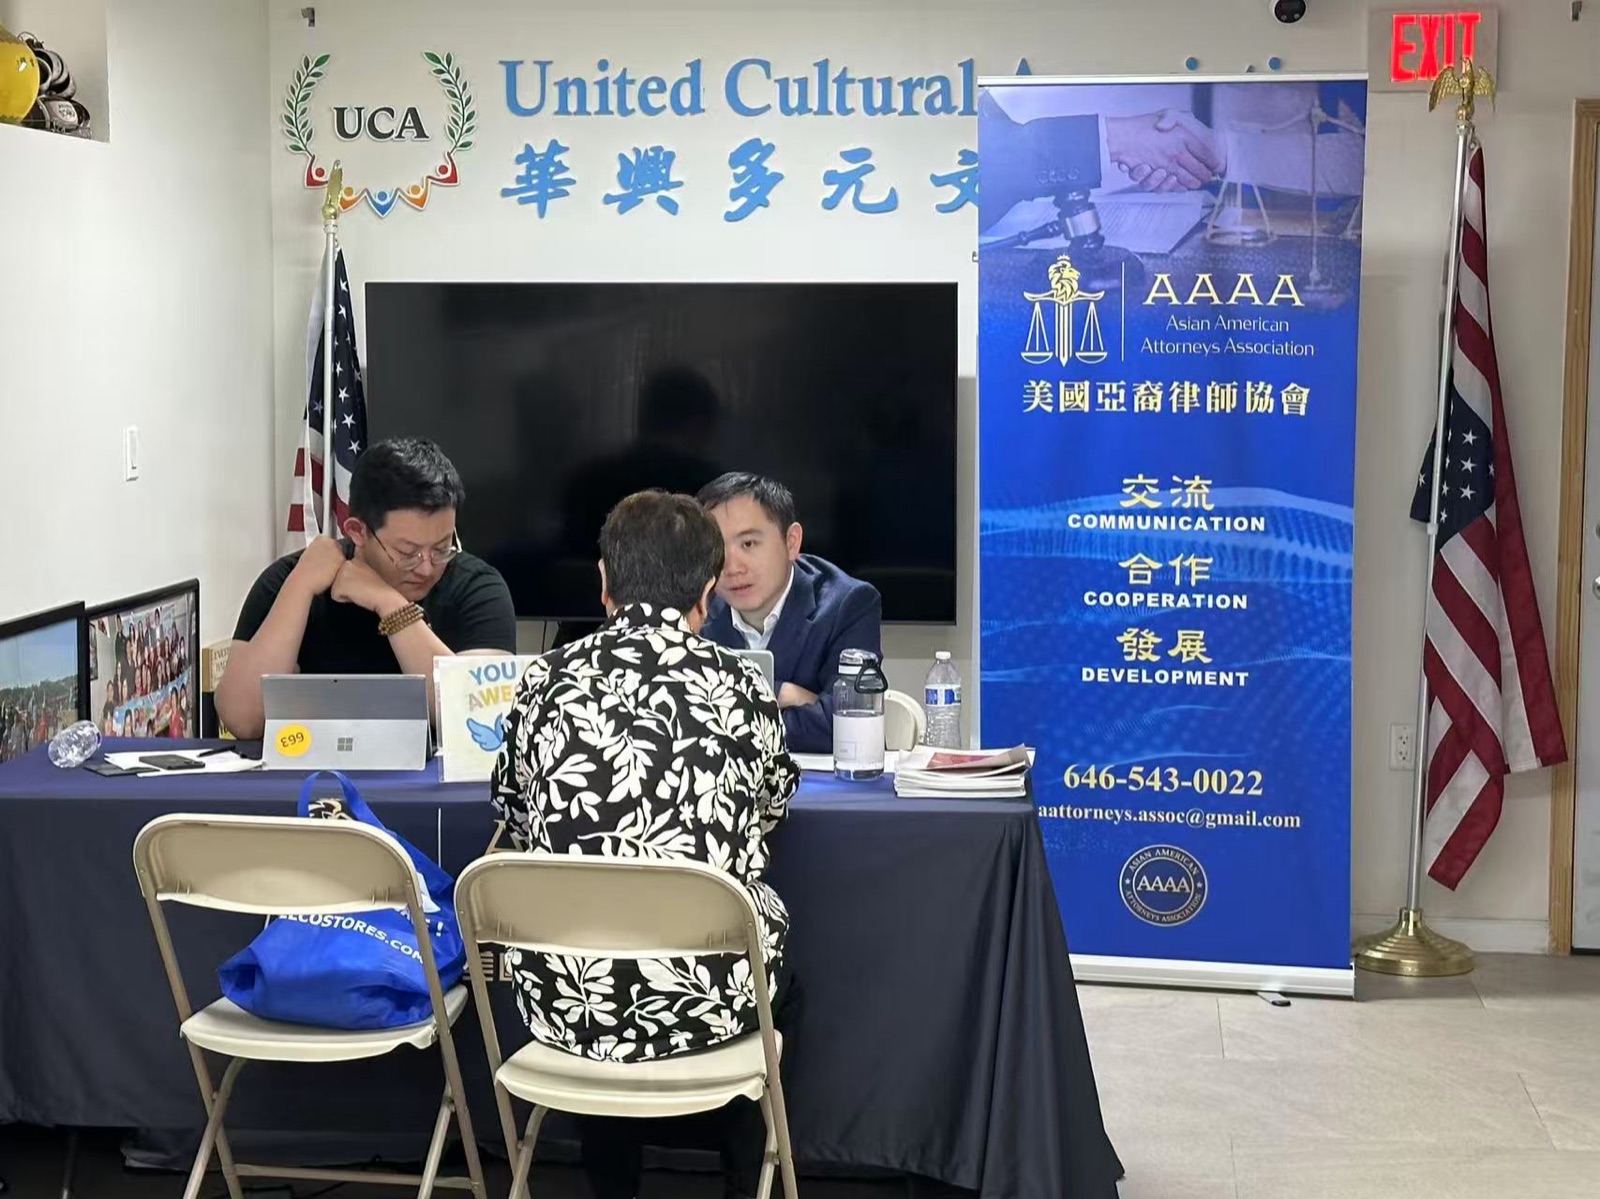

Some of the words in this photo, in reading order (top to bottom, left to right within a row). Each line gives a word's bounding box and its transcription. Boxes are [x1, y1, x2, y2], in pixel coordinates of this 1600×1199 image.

[1391, 12, 1481, 82] EXIT
[499, 58, 705, 118] United
[724, 57, 978, 118] Cultural
[333, 106, 429, 140] UCA
[1142, 273, 1305, 307] AAAA
[1166, 315, 1210, 331] Asian
[1214, 315, 1289, 333] American
[1140, 339, 1221, 356] Attorneys
[1223, 338, 1315, 356] Association
[1022, 380, 1311, 416] 美國亞裔律師協會
[1119, 473, 1215, 510] 交流
[1067, 513, 1266, 532] COMMUNICATION
[1118, 552, 1213, 587] 合作
[1083, 590, 1248, 610] COOPERATION
[1116, 627, 1213, 664] 發展
[469, 661, 517, 685] YOU
[1081, 667, 1249, 687] DEVELOPMENT
[1063, 763, 1264, 796] 646-543-0022
[1038, 803, 1302, 829] aattorneys.assoc@gmail.com
[1128, 851, 1152, 873] ASIAN
[1154, 848, 1199, 876] AMERICAN
[1136, 874, 1191, 893] AAAA
